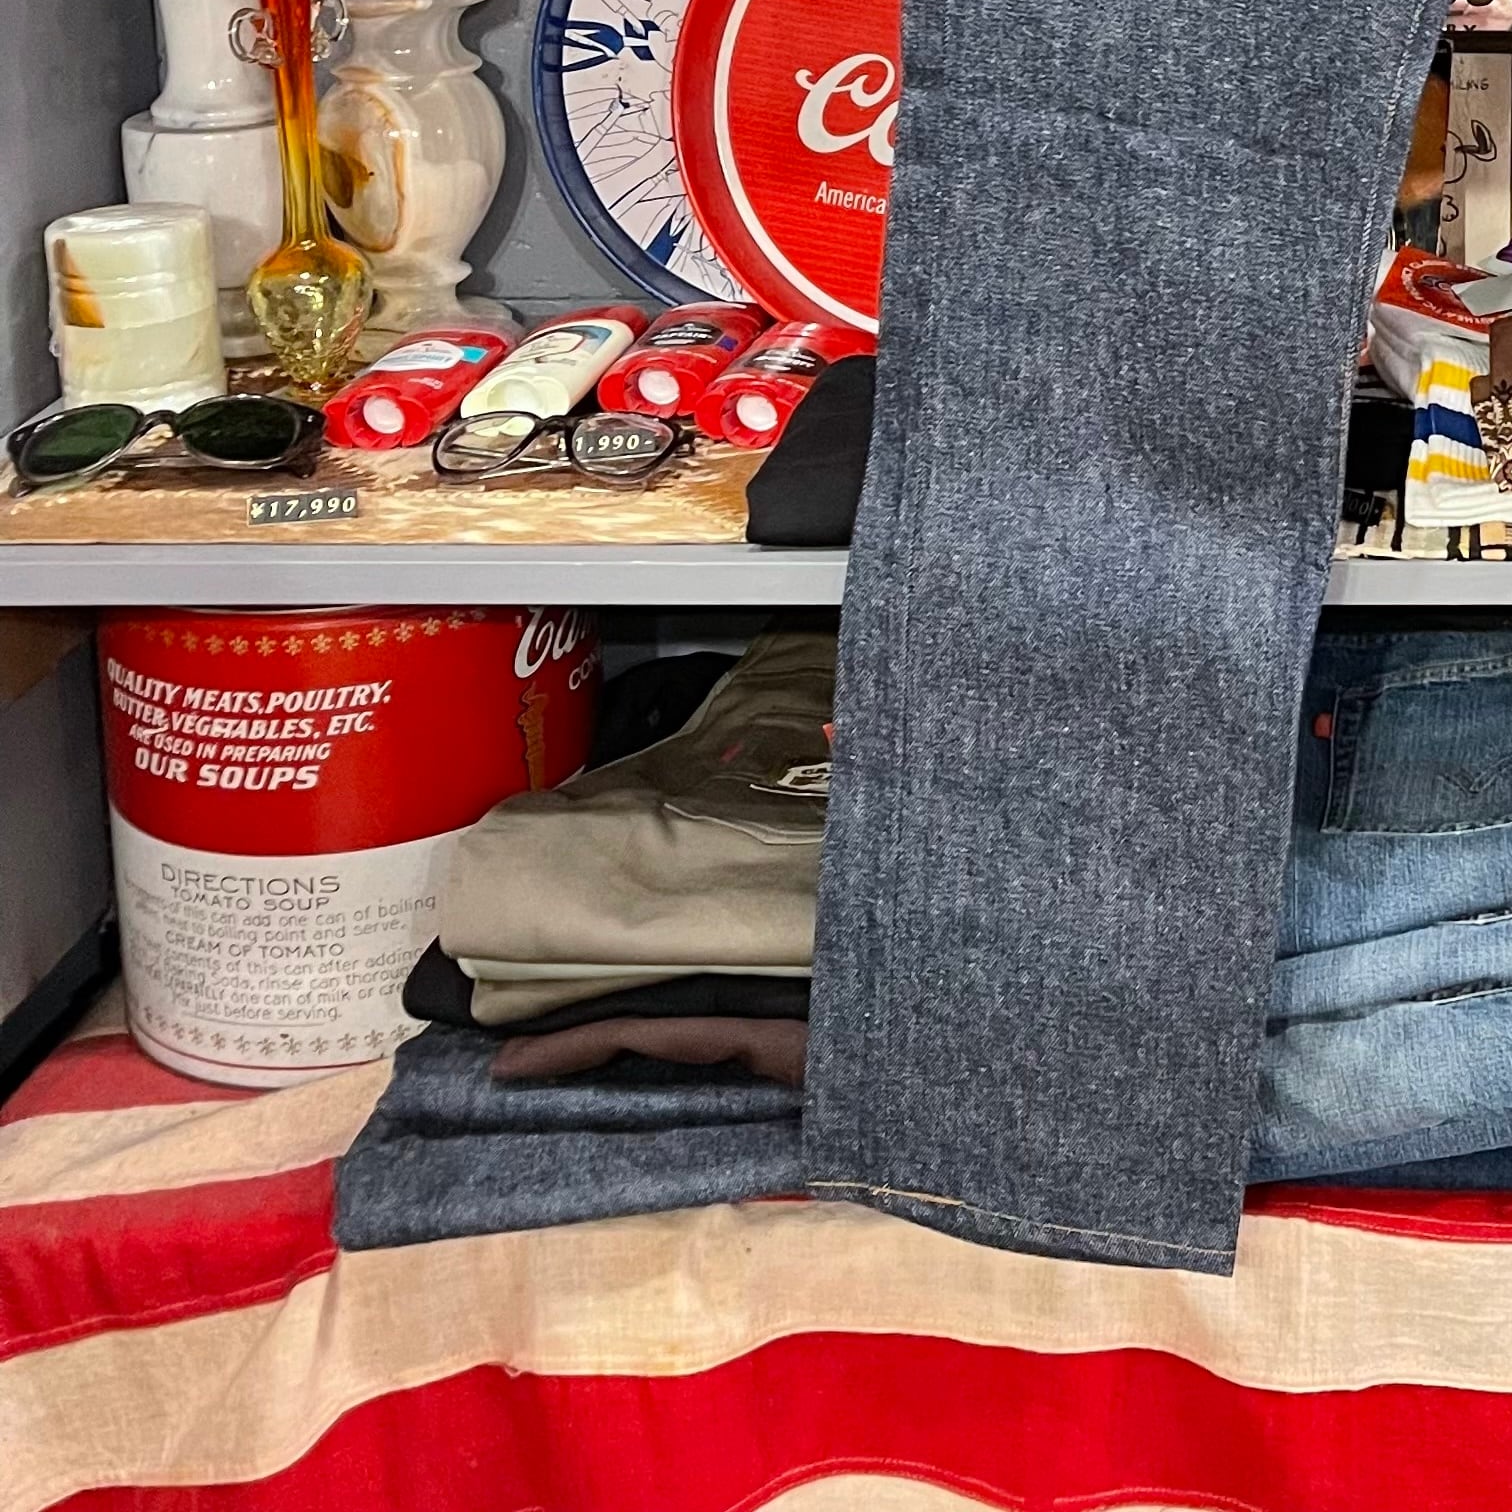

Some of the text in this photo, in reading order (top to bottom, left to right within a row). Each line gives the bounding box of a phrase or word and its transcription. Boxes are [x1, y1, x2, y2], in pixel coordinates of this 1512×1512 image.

[250, 496, 356, 519] ¥17,990
[107, 657, 183, 705] QUALITY
[326, 710, 375, 736] ETC.
[129, 723, 332, 763] ARE USED IN PREPARING
[135, 747, 320, 790] OUR SOUPS
[161, 863, 340, 896] DIRECTIONS
[171, 886, 250, 910] TOMATO
[264, 897, 330, 911] SOUP
[243, 914, 271, 927] add
[279, 914, 308, 927] one
[315, 912, 346, 926] can
[353, 904, 371, 921] of
[165, 929, 344, 959] CREAM OF TOMATO
[312, 926, 346, 939] and
[226, 959, 240, 972] of
[247, 961, 277, 976] this
[284, 963, 312, 976] can
[318, 958, 359, 975] after
[310, 976, 339, 989] can
[231, 991, 259, 1004] one
[264, 993, 291, 1006] can
[296, 990, 312, 1005] of
[358, 988, 374, 1000] or
[224, 1004, 271, 1020] before
